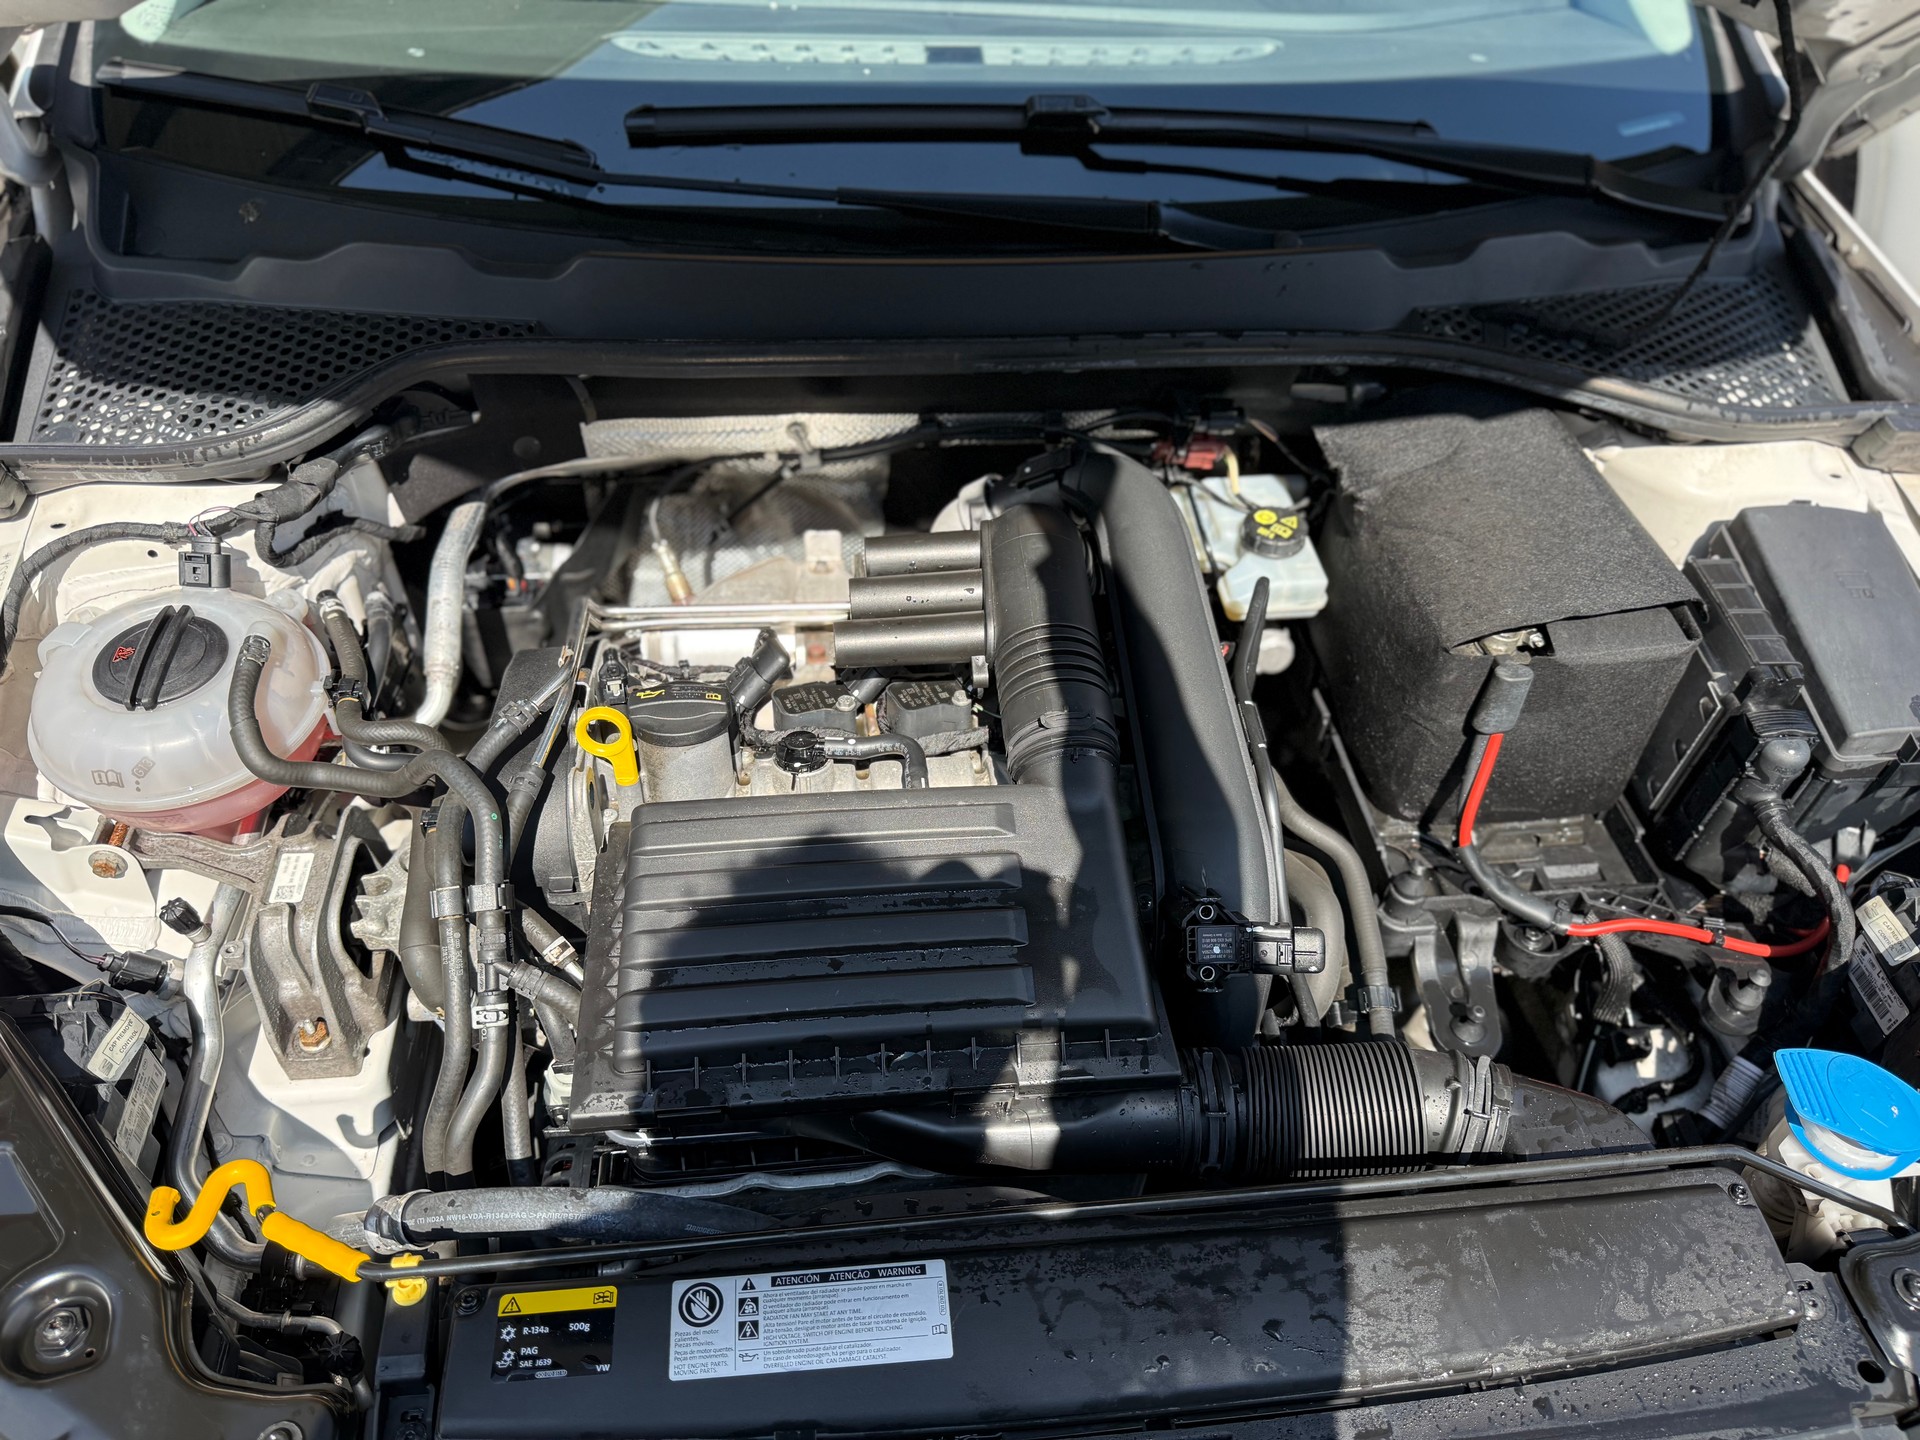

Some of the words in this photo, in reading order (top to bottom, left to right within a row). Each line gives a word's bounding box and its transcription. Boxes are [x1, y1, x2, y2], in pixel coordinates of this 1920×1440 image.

[134, 758, 153, 777] G13
[1877, 929, 1896, 952] CONTROL
[119, 1029, 140, 1054] CONTROL
[776, 1274, 820, 1286] ATENCIÓN
[828, 1268, 870, 1282] ATENÇÃO
[878, 1266, 921, 1277] WARNING
[522, 1326, 549, 1335] R-134a
[569, 1322, 590, 1332] 500g
[520, 1346, 538, 1356] PAG
[520, 1360, 532, 1368] SAE
[535, 1358, 552, 1366] J639
[596, 1364, 610, 1372] VW
